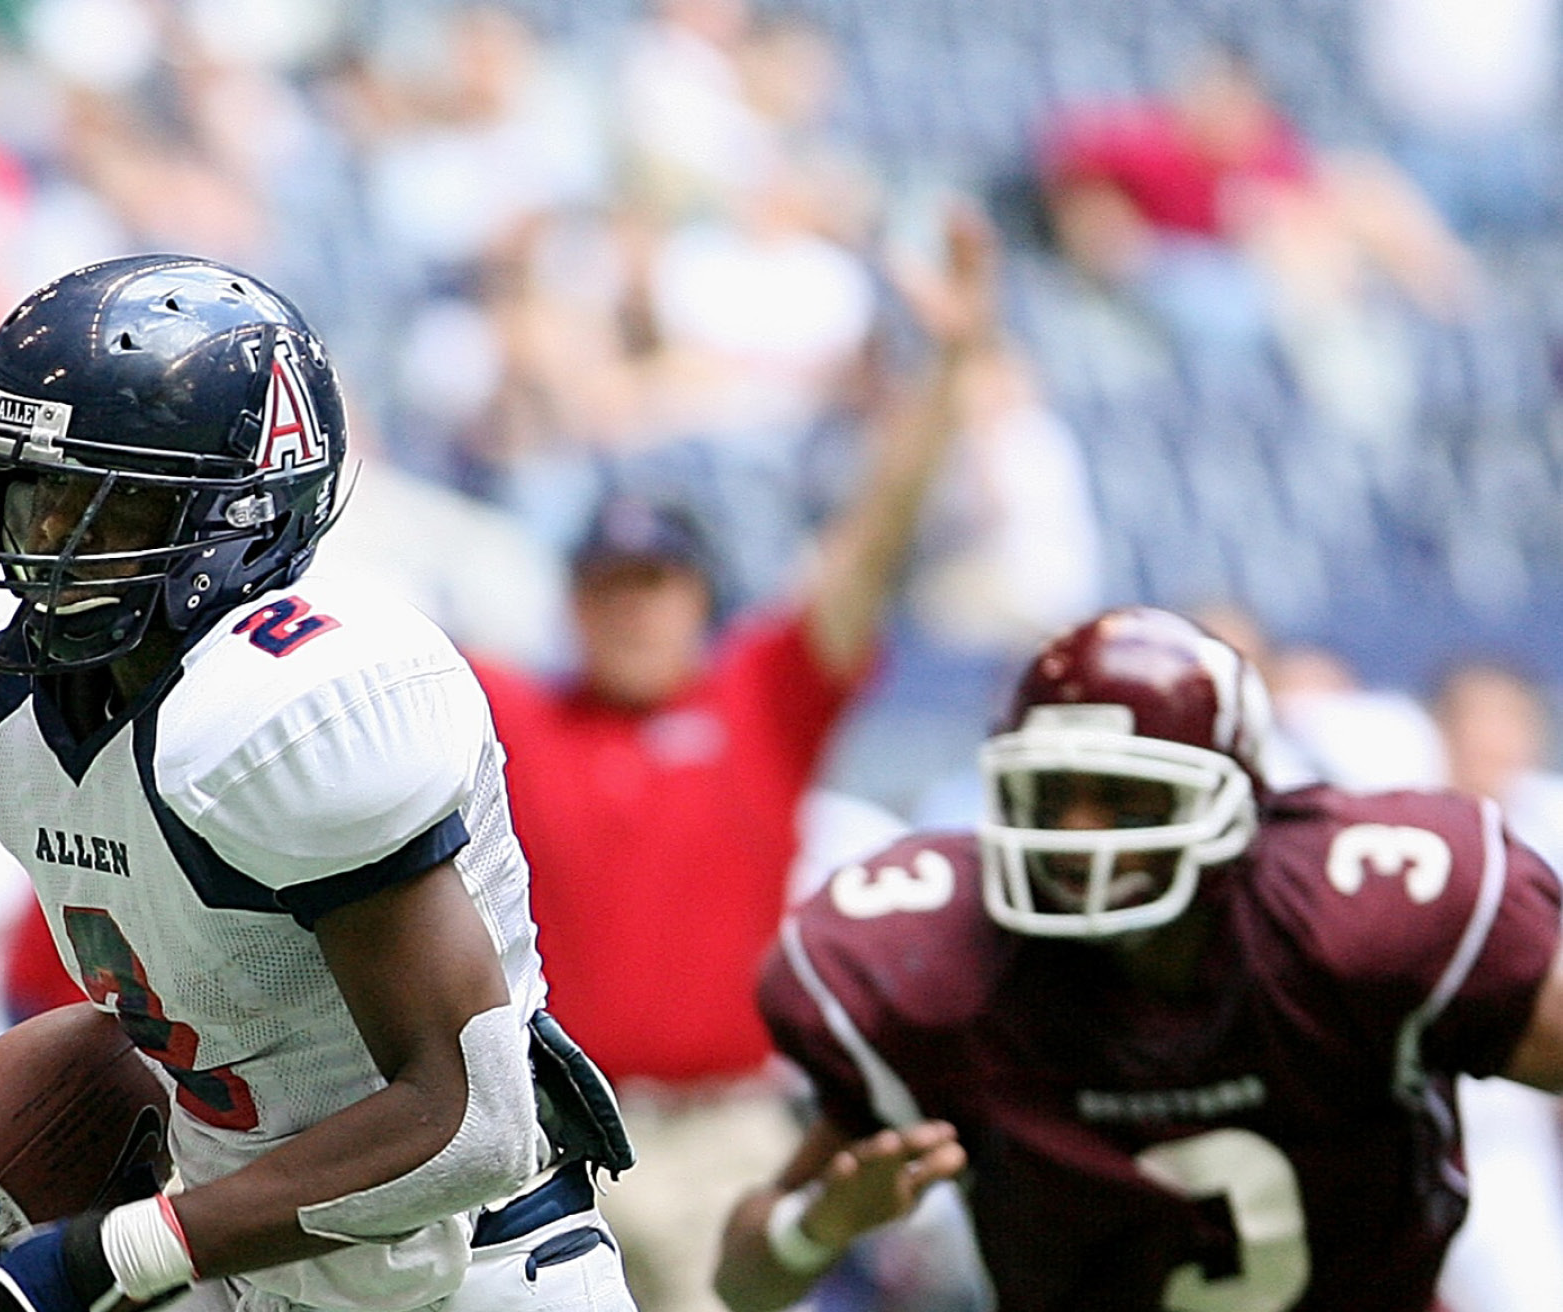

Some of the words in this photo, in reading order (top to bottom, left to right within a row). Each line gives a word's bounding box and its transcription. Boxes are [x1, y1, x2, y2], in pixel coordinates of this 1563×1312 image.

[242, 332, 329, 481] A
[231, 595, 342, 658] 2
[35, 827, 131, 878] ALLEN
[830, 849, 954, 919] 3
[1322, 823, 1453, 904] 3
